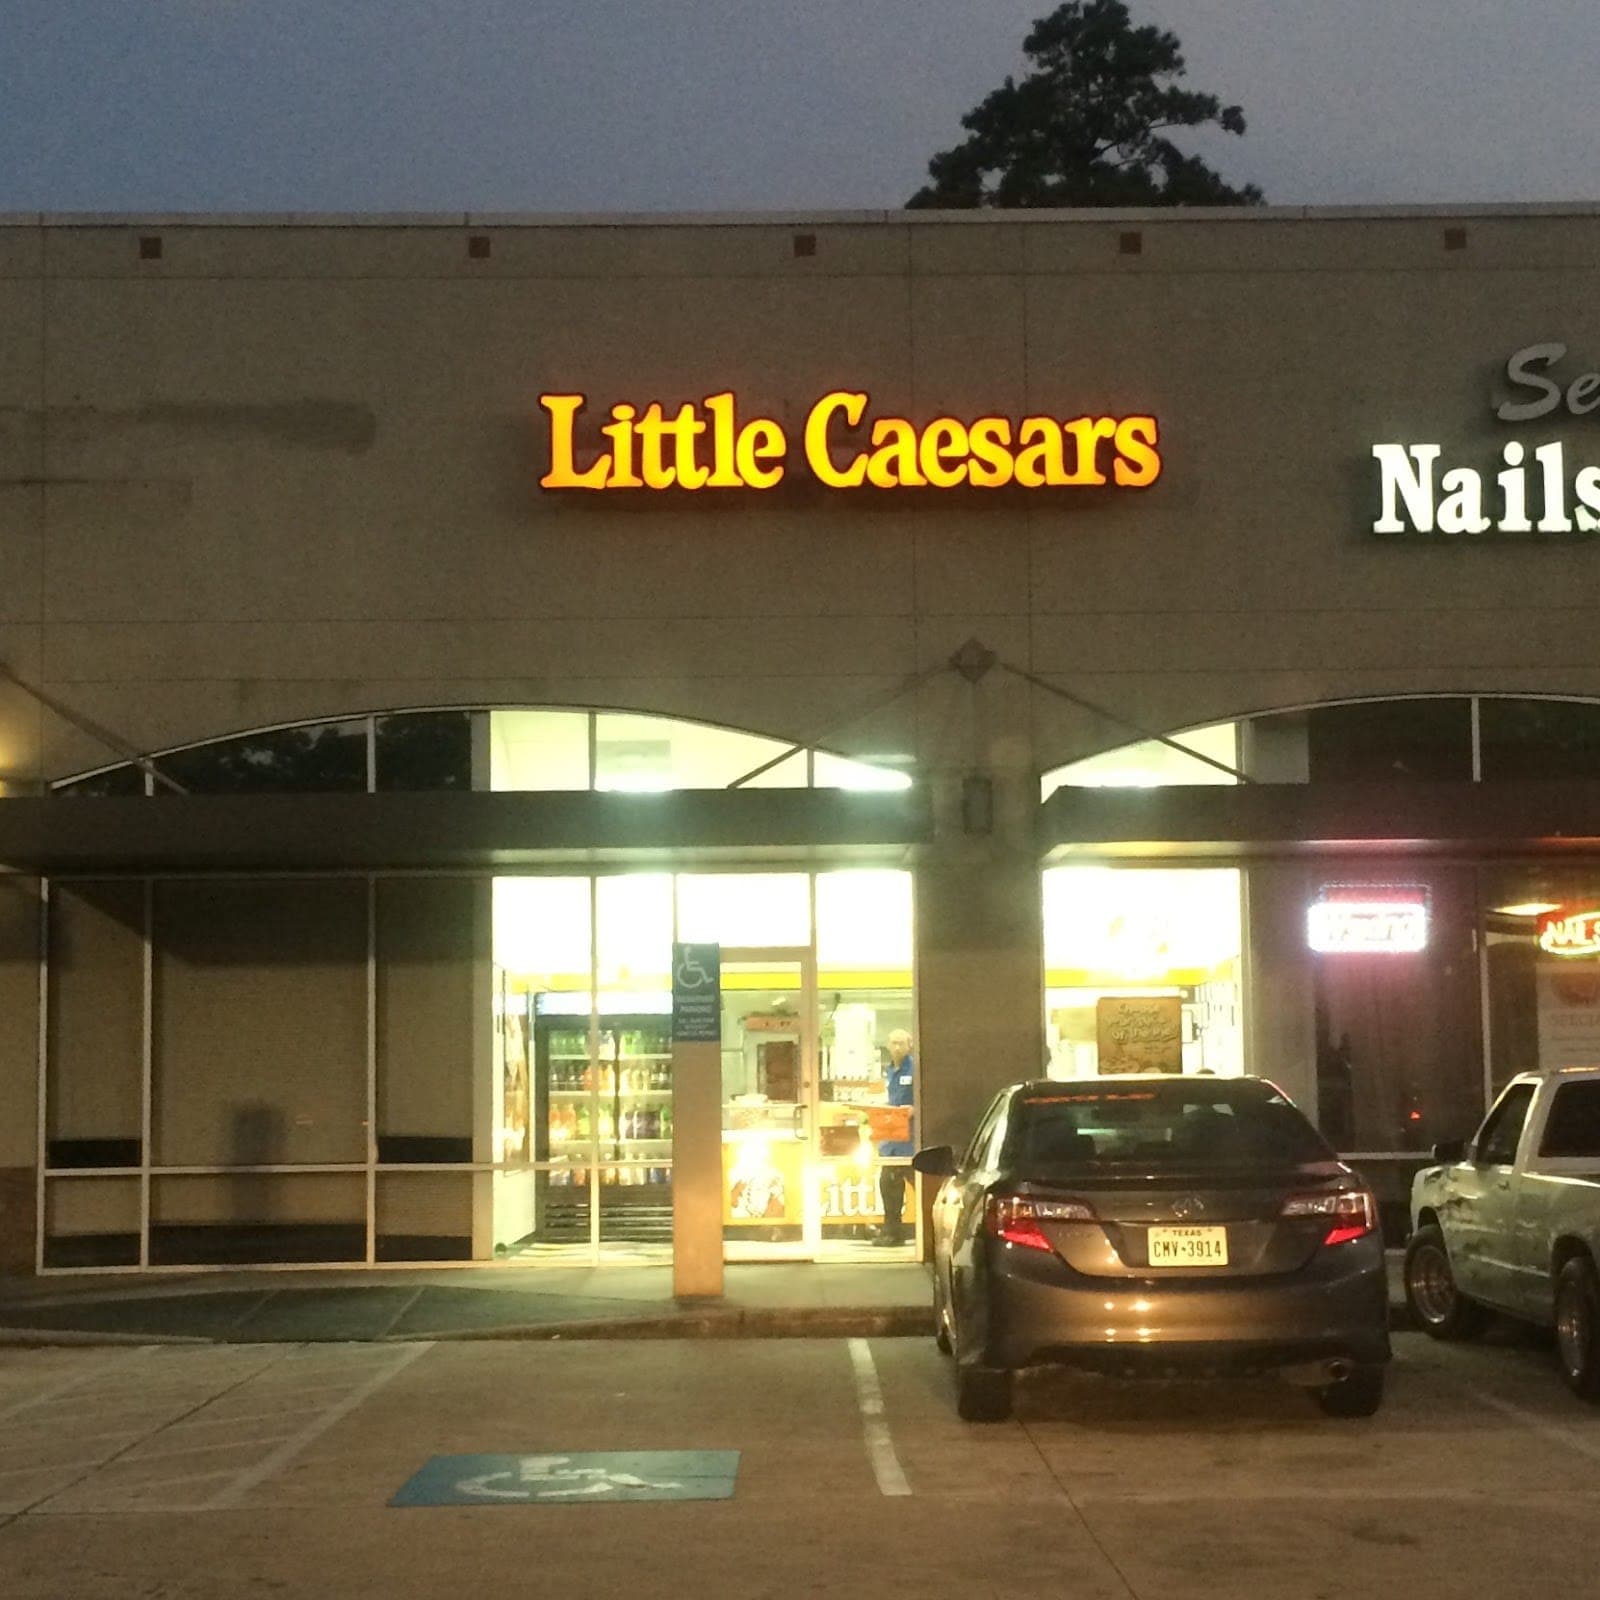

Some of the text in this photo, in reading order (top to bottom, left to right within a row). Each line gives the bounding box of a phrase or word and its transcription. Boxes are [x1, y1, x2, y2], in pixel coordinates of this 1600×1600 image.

[1496, 342, 1600, 421] Se
[540, 391, 1161, 490] Little Caesars
[1371, 440, 1600, 535] Nails
[1172, 1229, 1202, 1237] TEXAS
